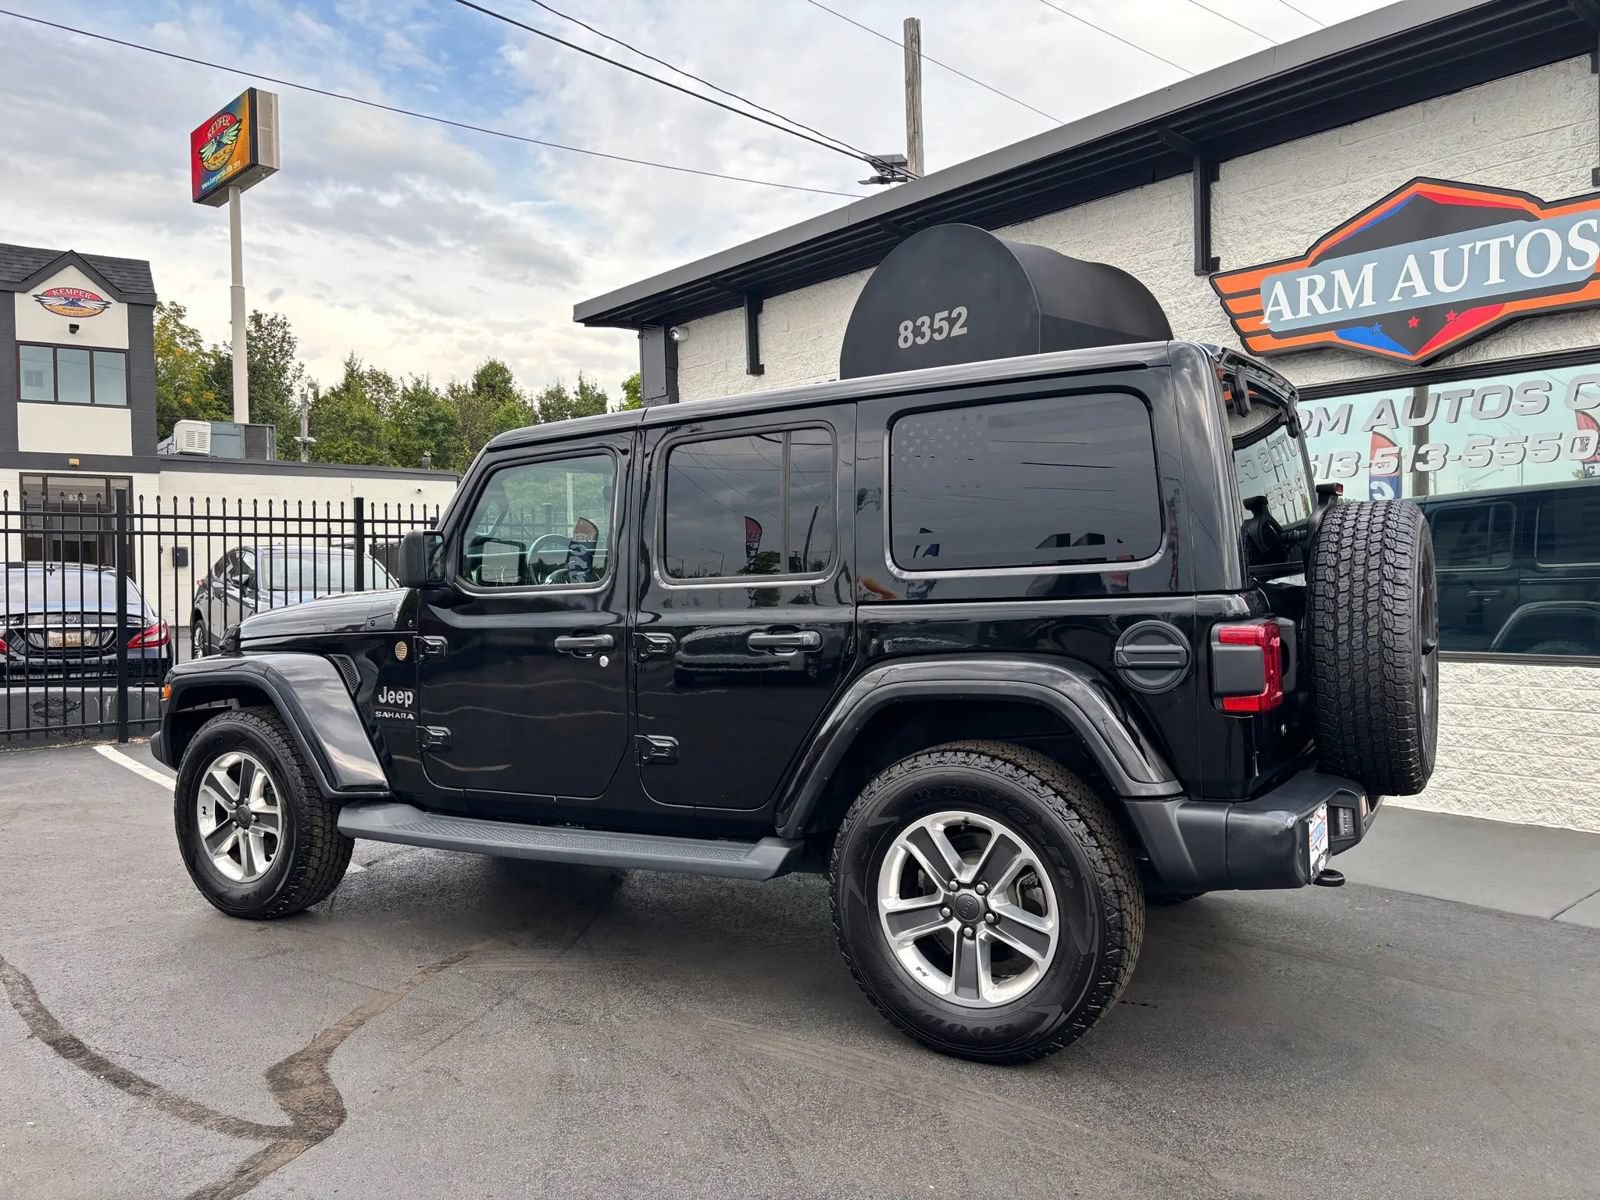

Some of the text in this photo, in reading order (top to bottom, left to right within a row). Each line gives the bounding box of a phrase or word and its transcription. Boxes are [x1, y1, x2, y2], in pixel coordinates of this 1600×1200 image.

[1259, 218, 1599, 326] ARM AUTOS
[52, 288, 92, 299] KEMPER
[898, 305, 968, 349] 8352
[1361, 379, 1553, 433] AUTOS
[68, 494, 88, 502] 832
[378, 686, 414, 708] Jeep
[375, 710, 415, 720] SAHARA
